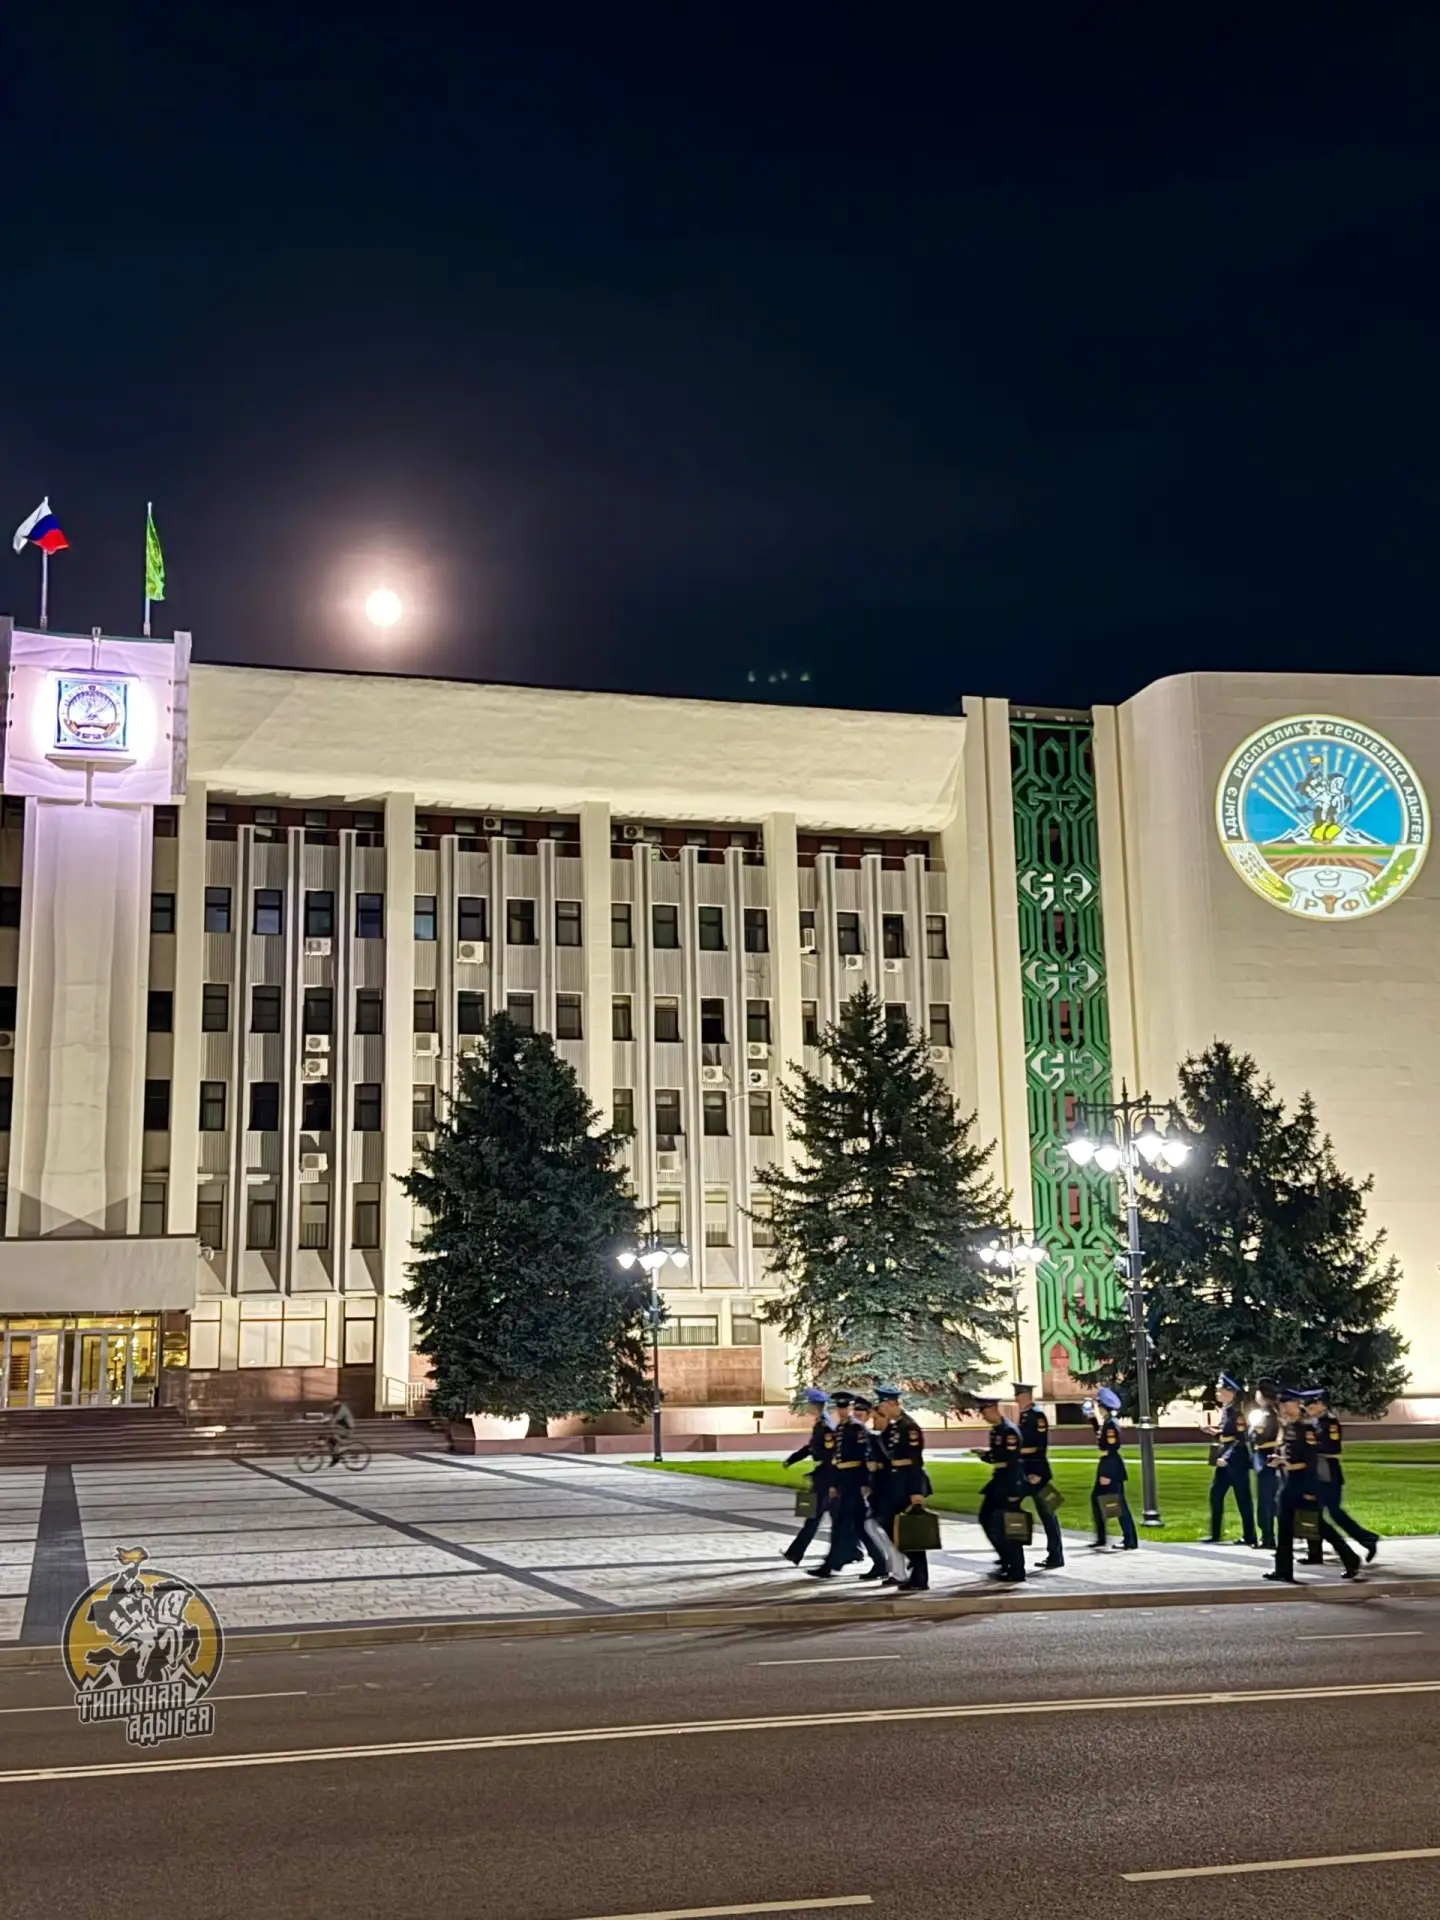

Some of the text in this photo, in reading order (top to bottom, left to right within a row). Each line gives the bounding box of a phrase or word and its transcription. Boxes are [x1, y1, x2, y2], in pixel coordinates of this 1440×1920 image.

[1225, 723, 1304, 836] АДЫГЭ РЕСПУБЛИК
[1324, 723, 1423, 843] РЕСПУБЛИКА АДЫГЕЯ
